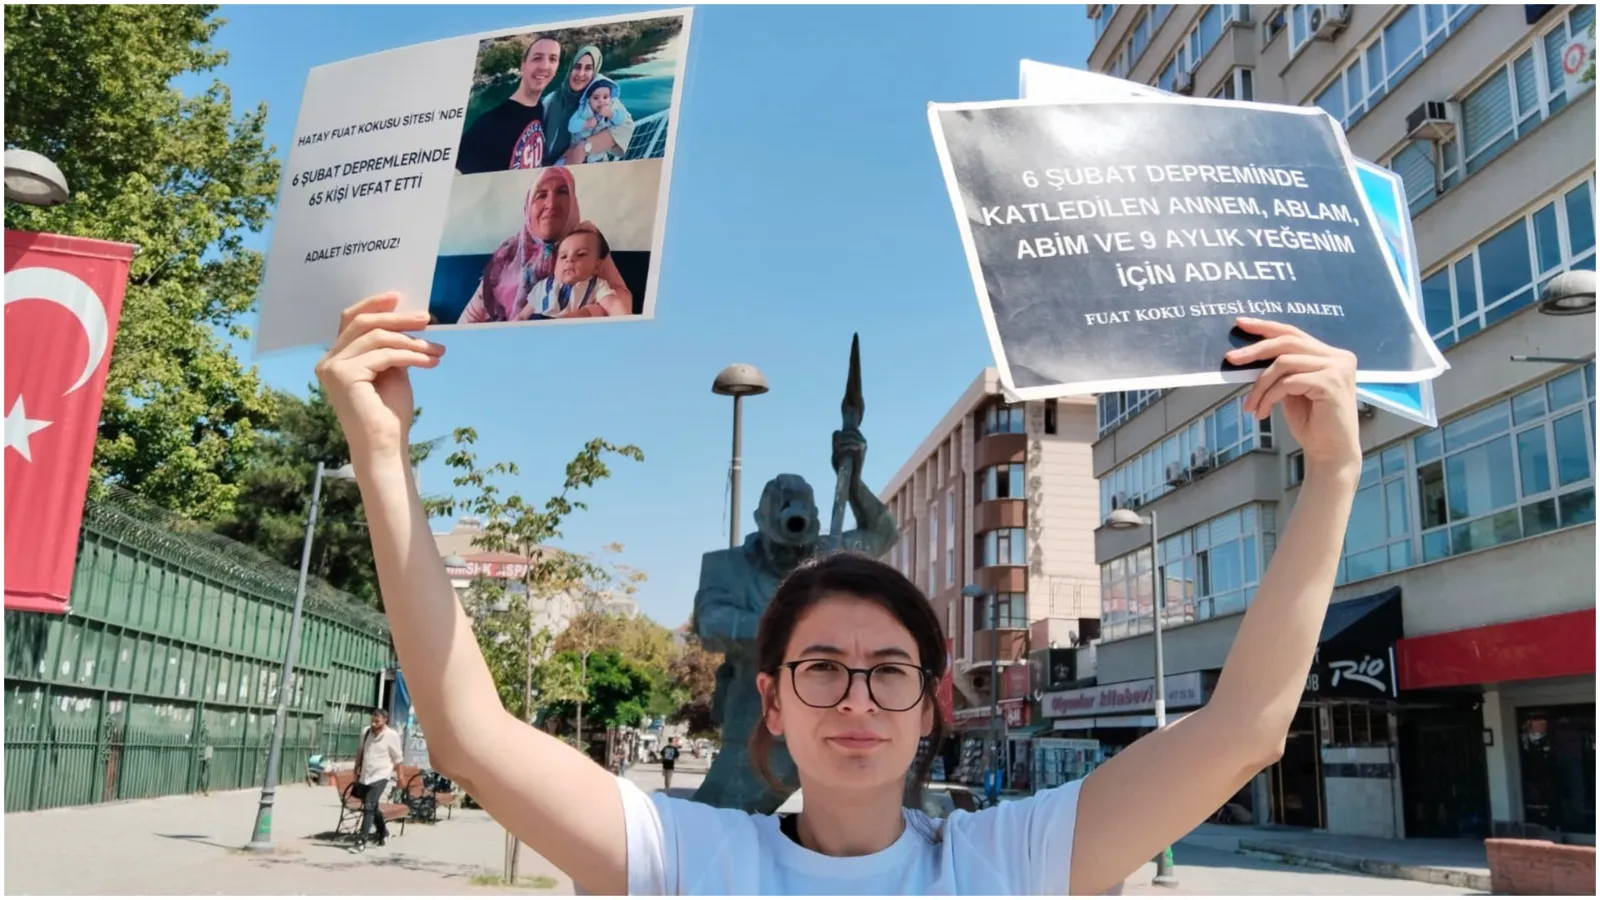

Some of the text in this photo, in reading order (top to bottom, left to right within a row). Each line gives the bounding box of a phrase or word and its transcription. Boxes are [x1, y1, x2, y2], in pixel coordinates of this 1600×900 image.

[298, 131, 330, 147] HATAY
[331, 125, 357, 140] FUAT
[357, 117, 402, 135] KOKUSU
[402, 110, 434, 126] SİTESİ
[292, 147, 452, 187] 6 ŞUBAT DEPREMLERİNDE
[1022, 163, 1309, 191] 6 ŞUBAT DEPREMİNDE
[308, 172, 424, 207] 65 KİŞİ VEFAT ETTİ
[981, 195, 1360, 227] KATLEDİLEN ANNEM, ABLAM,
[304, 237, 401, 264] ADALET İSTİYORUZ!
[1017, 225, 1356, 260] ABİM VE 9 AYLIK YEĞENİM
[1115, 261, 1297, 292] İÇİN ADALET!
[1084, 299, 1345, 326] FUAT KOKU SİTESİ İÇİN ADALET!
